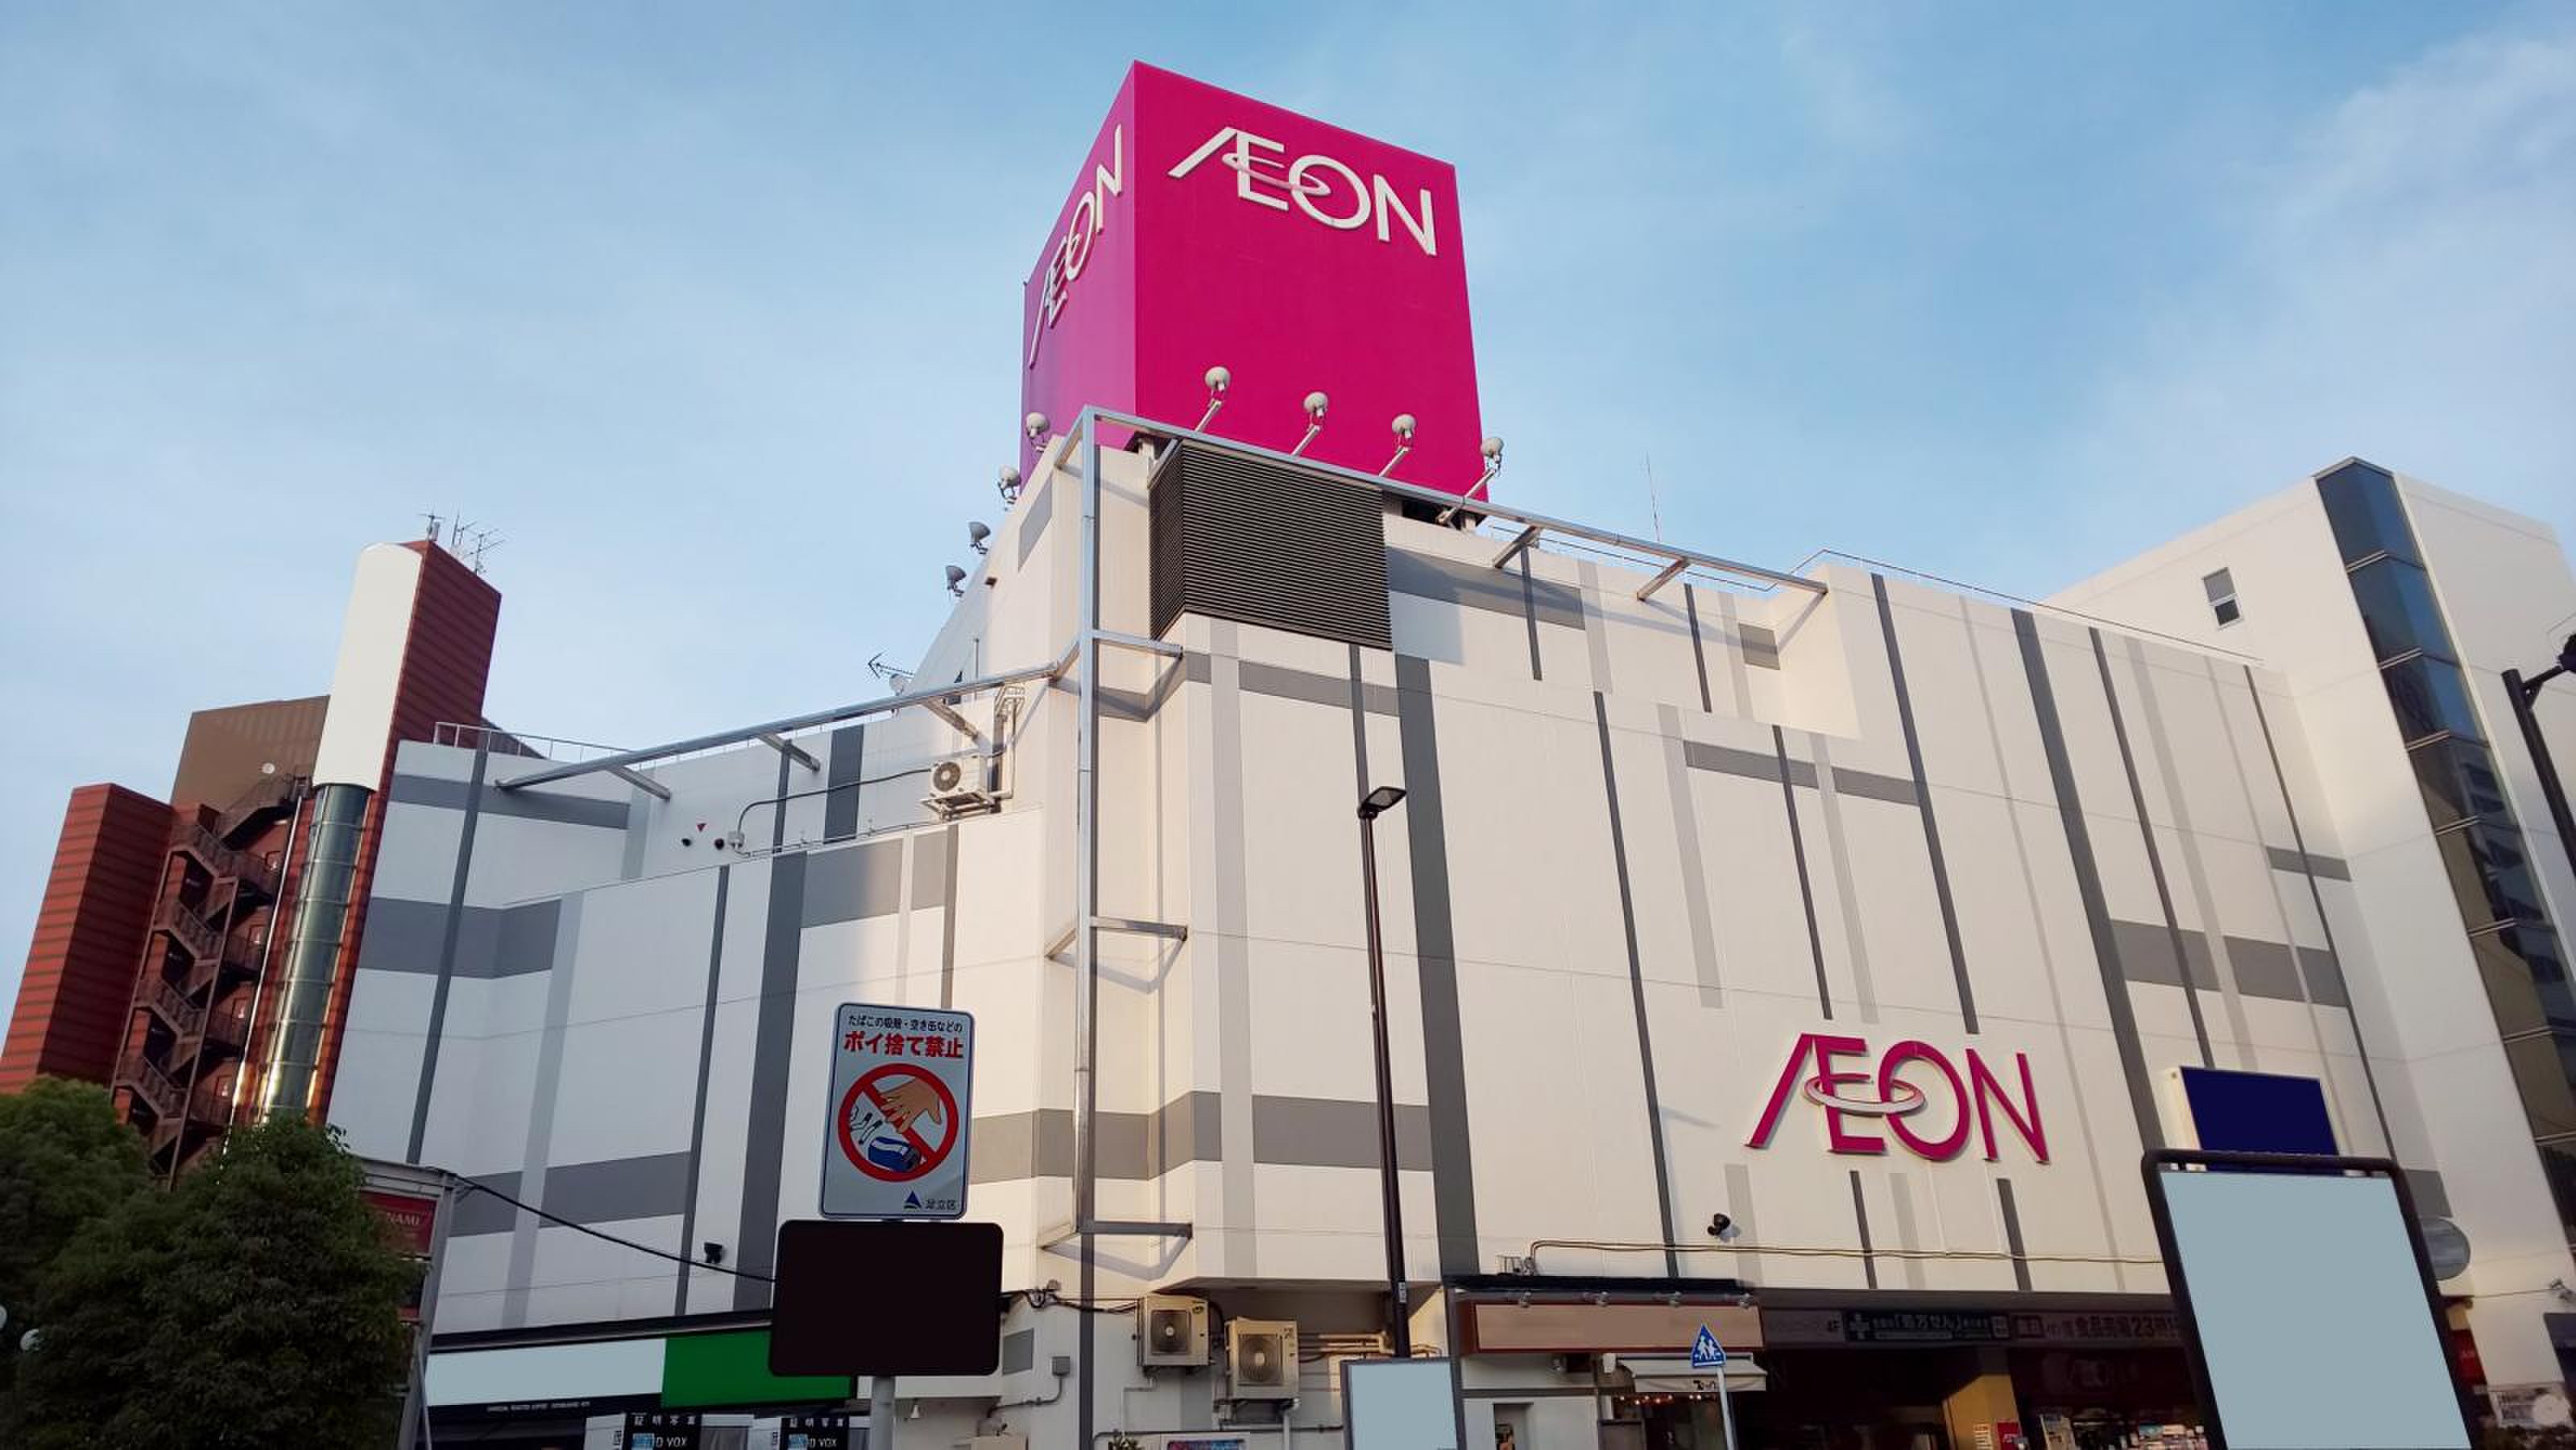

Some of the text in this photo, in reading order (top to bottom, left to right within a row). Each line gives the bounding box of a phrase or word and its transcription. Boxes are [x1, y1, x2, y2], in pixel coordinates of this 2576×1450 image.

[843, 1030, 964, 1058] ポイ捨て禁止
